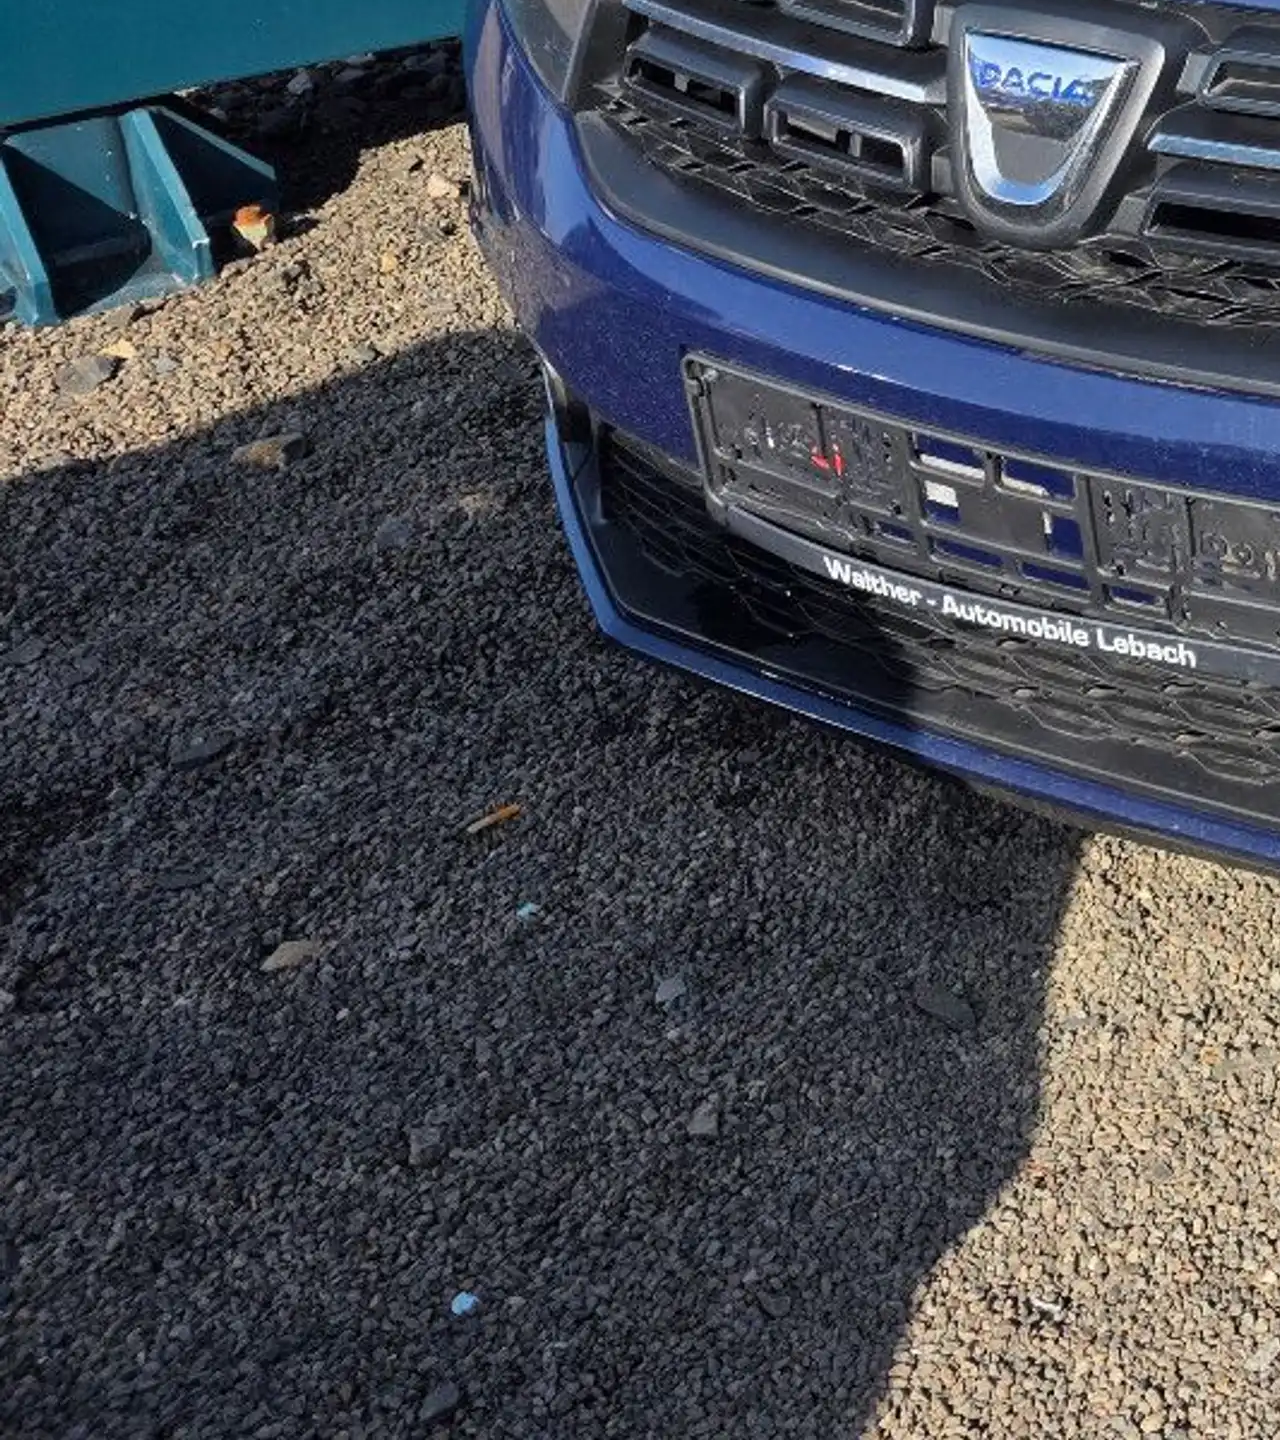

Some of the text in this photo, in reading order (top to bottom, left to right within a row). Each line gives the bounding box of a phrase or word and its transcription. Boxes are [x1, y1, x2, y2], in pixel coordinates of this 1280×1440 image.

[977, 61, 1091, 106] DACIA
[822, 553, 923, 607] Walther
[940, 593, 1091, 650] Automobile
